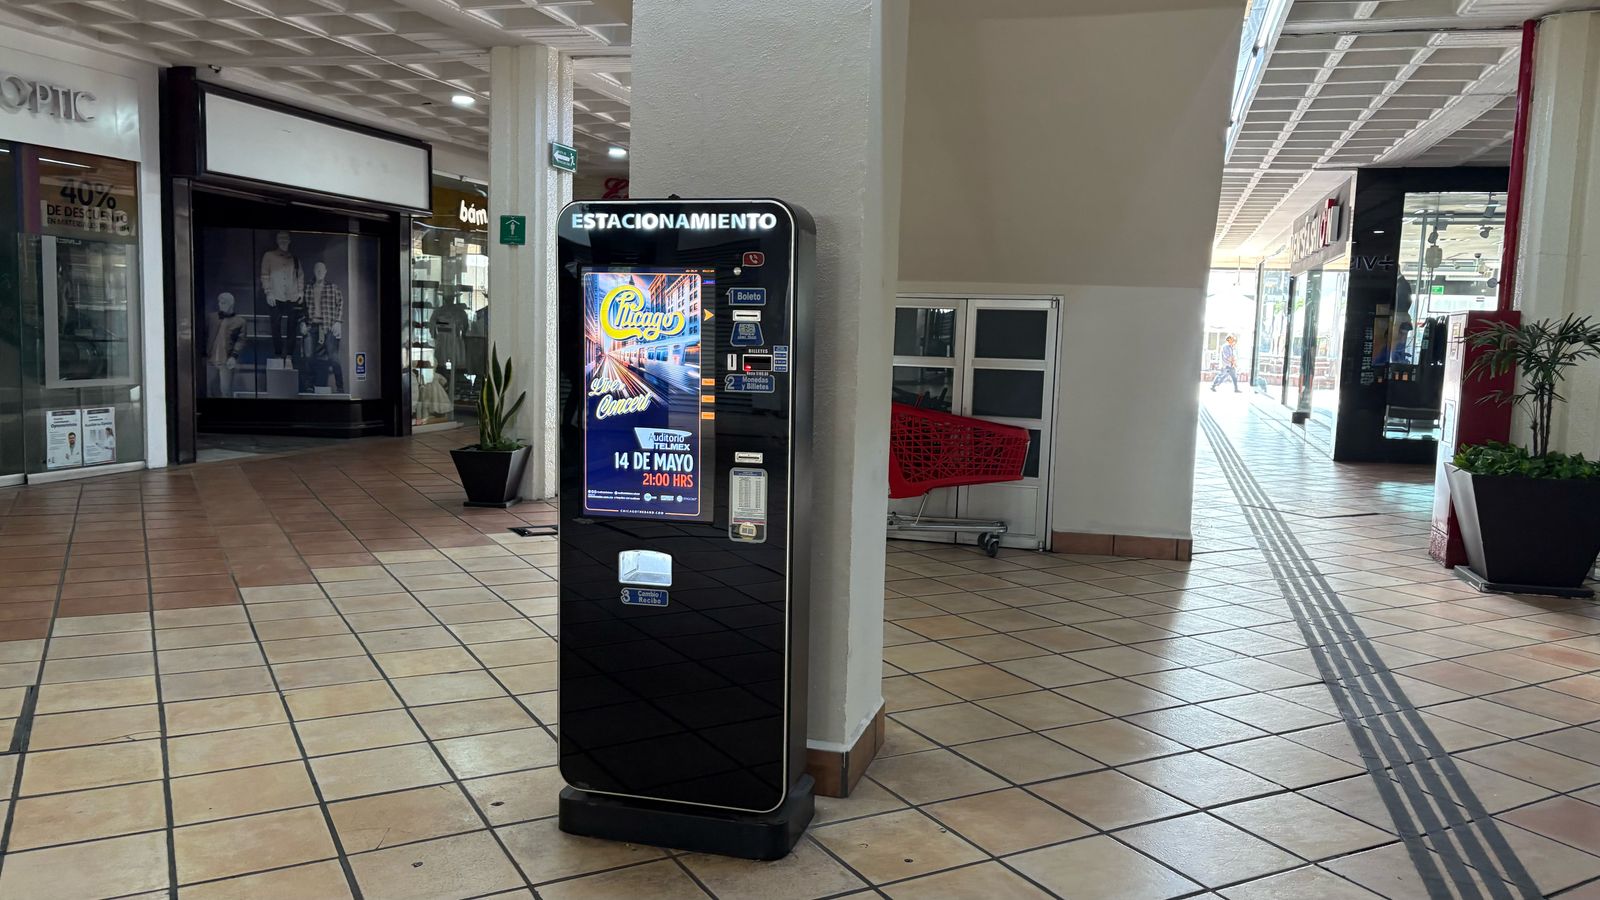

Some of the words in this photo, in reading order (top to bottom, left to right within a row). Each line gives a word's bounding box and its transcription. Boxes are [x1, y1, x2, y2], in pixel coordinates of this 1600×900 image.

[60, 179, 117, 209] 40%
[47, 204, 61, 216] DE
[64, 205, 128, 224] DESCUENTO
[459, 199, 488, 226] bám
[571, 212, 778, 231] ESTACIONAMIENTO
[737, 291, 762, 301] Boleto
[600, 284, 685, 342] Chicago
[727, 376, 735, 390] 2
[596, 391, 652, 420] Concert
[648, 432, 685, 443] Auditorio
[653, 442, 691, 451] TELMEX
[614, 451, 630, 470] 14
[633, 451, 651, 470] DE
[653, 452, 694, 473] MAYO
[643, 473, 670, 487] 21:00
[673, 474, 694, 488] HRS
[623, 589, 631, 603] 3
[637, 590, 659, 598] Cambio
